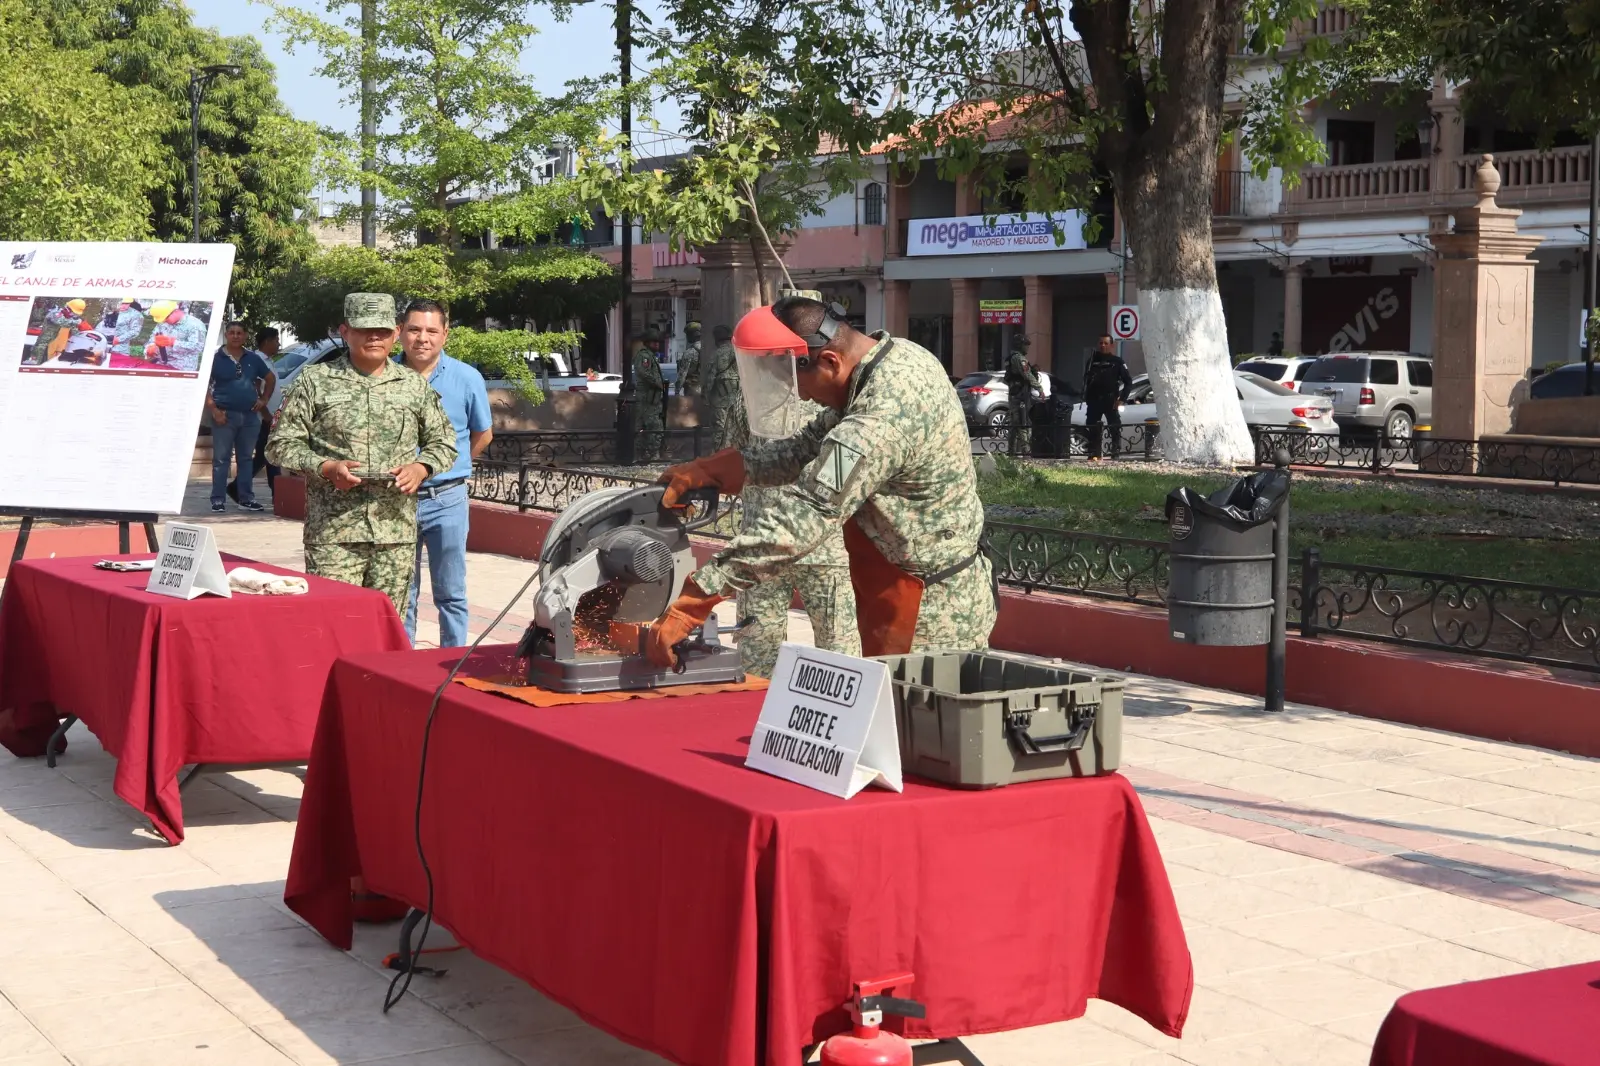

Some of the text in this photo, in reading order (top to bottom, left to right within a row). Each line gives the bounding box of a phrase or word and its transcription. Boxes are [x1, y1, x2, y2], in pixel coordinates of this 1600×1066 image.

[921, 222, 1046, 249] mega IMPORTACIONES
[971, 235, 1049, 246] MAYOREO Y MENUDEO
[158, 257, 208, 266] Michoacán
[14, 276, 59, 287] CANJE
[62, 278, 81, 287] DE
[85, 278, 134, 288] ARMAS
[137, 280, 178, 289] 2025.
[1120, 314, 1131, 332] E
[191, 533, 196, 548] 2
[161, 552, 195, 571] VERIFICACIÓN
[159, 571, 183, 588] DE DATOS
[844, 676, 856, 701] 5
[788, 705, 838, 741] CORTE E
[762, 729, 844, 777] INUTILIZACIÓN
